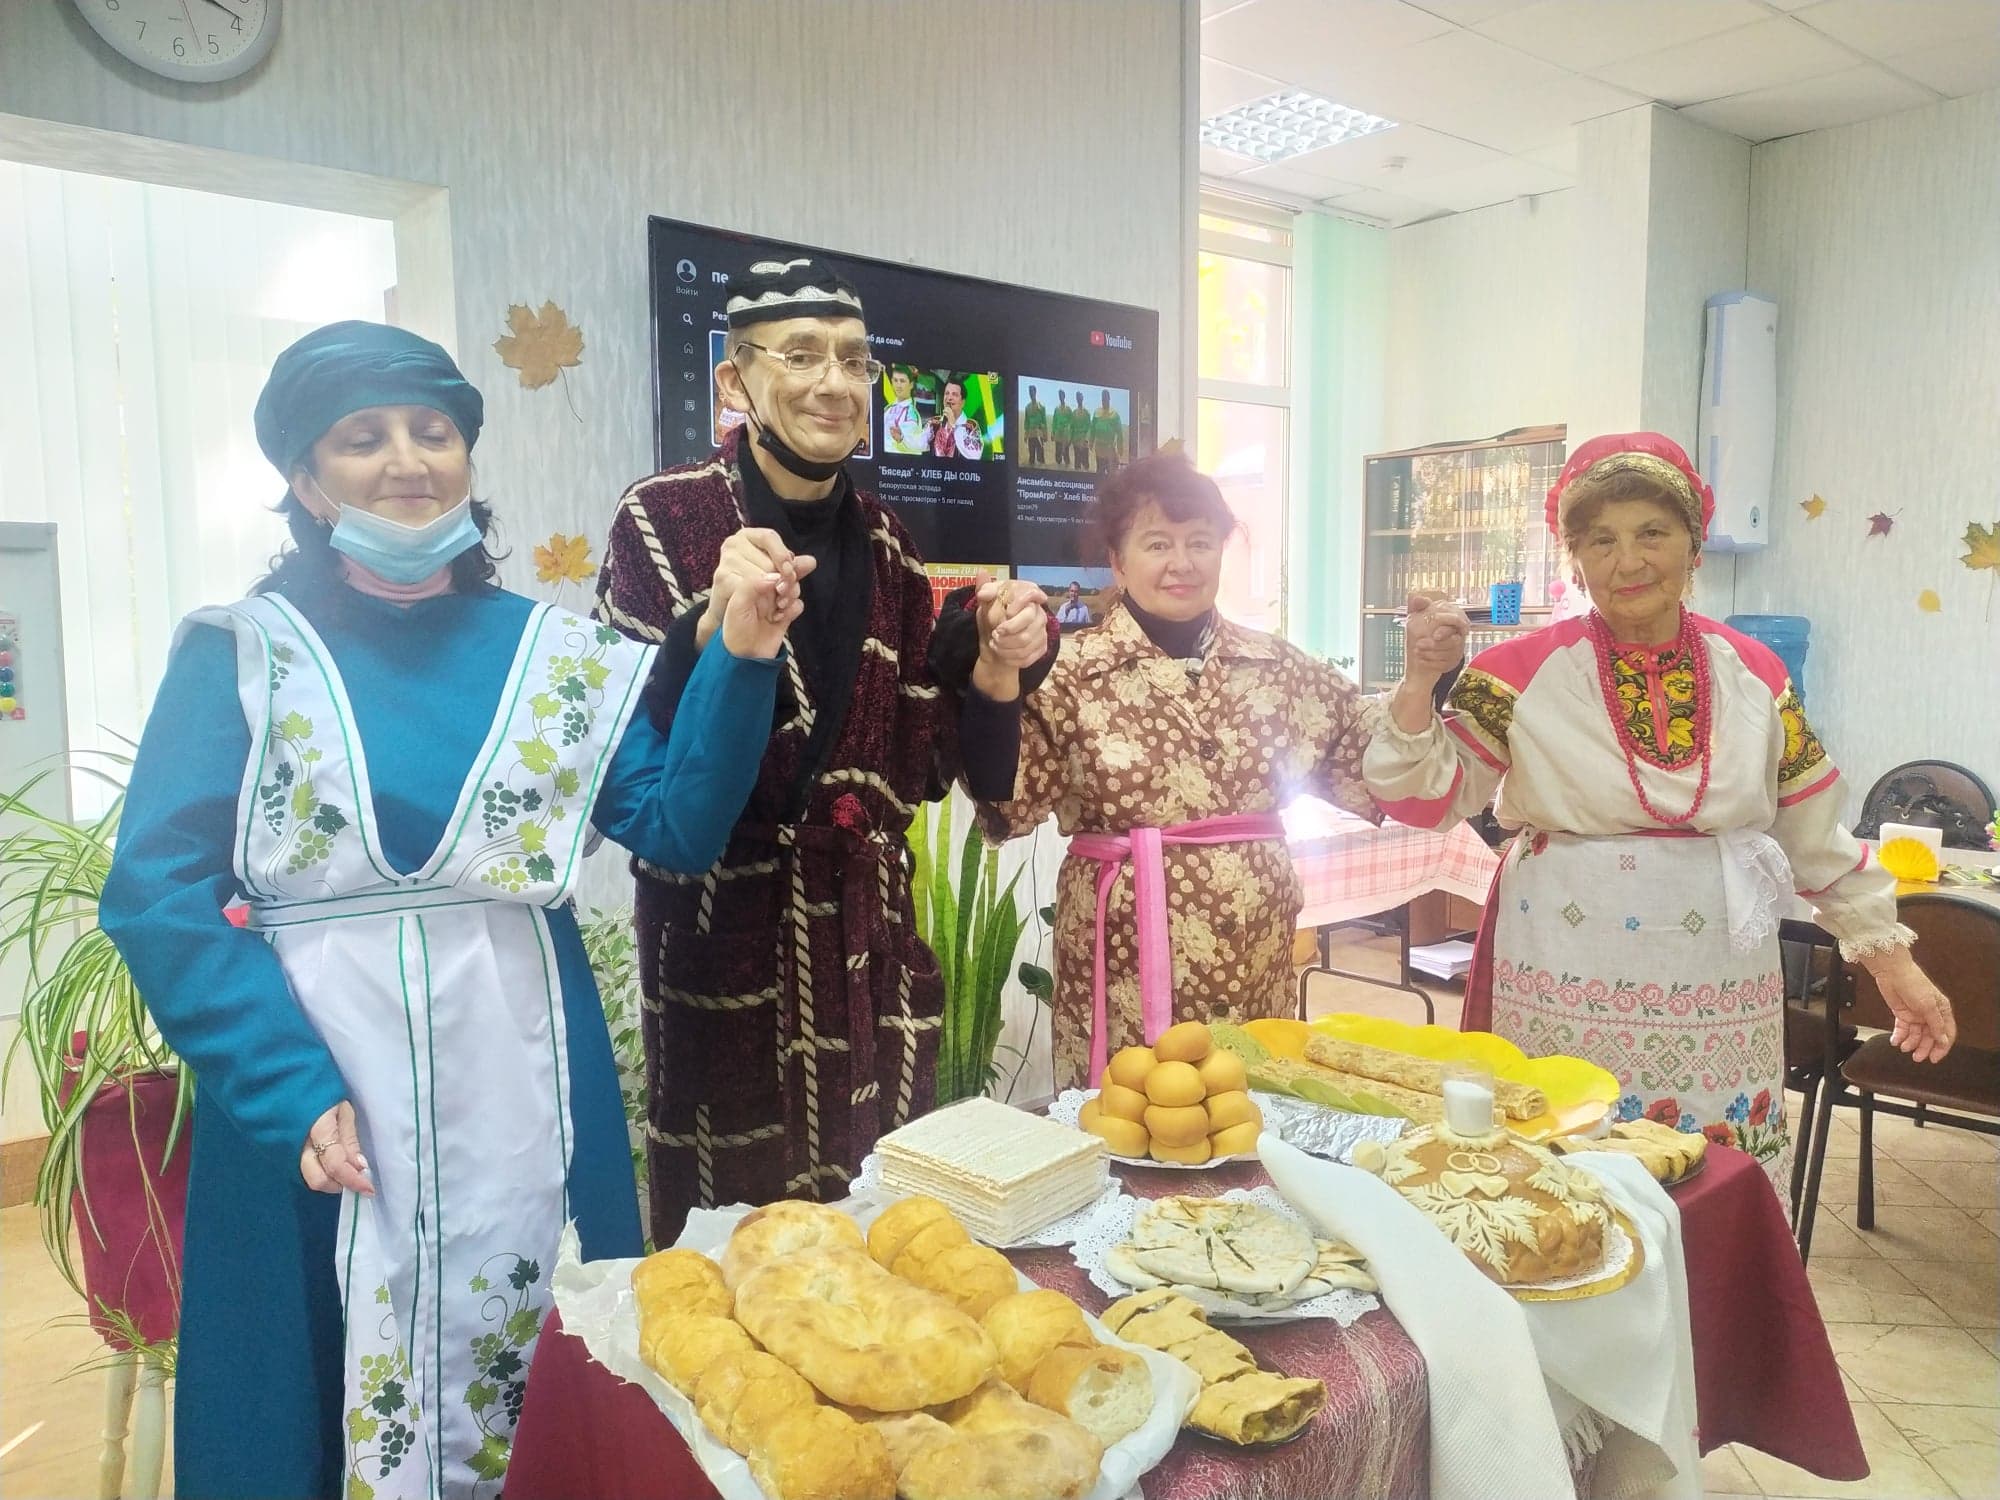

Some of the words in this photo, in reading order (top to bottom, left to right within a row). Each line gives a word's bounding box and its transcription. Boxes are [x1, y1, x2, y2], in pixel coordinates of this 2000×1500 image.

[136, 20, 146, 40] 7
[230, 16, 243, 36] 4
[173, 37, 185, 57] 6
[208, 34, 219, 55] 5
[676, 286, 699, 297] Войти
[1105, 333, 1133, 350] YouTube
[920, 469, 943, 480] ХЛЕБ
[943, 470, 958, 482] ДЫ
[959, 472, 981, 482] СОЛЬ
[1016, 476, 1053, 488] Ансамбль
[1053, 481, 1095, 490] ассоциации
[1063, 491, 1081, 502] Хлеб
